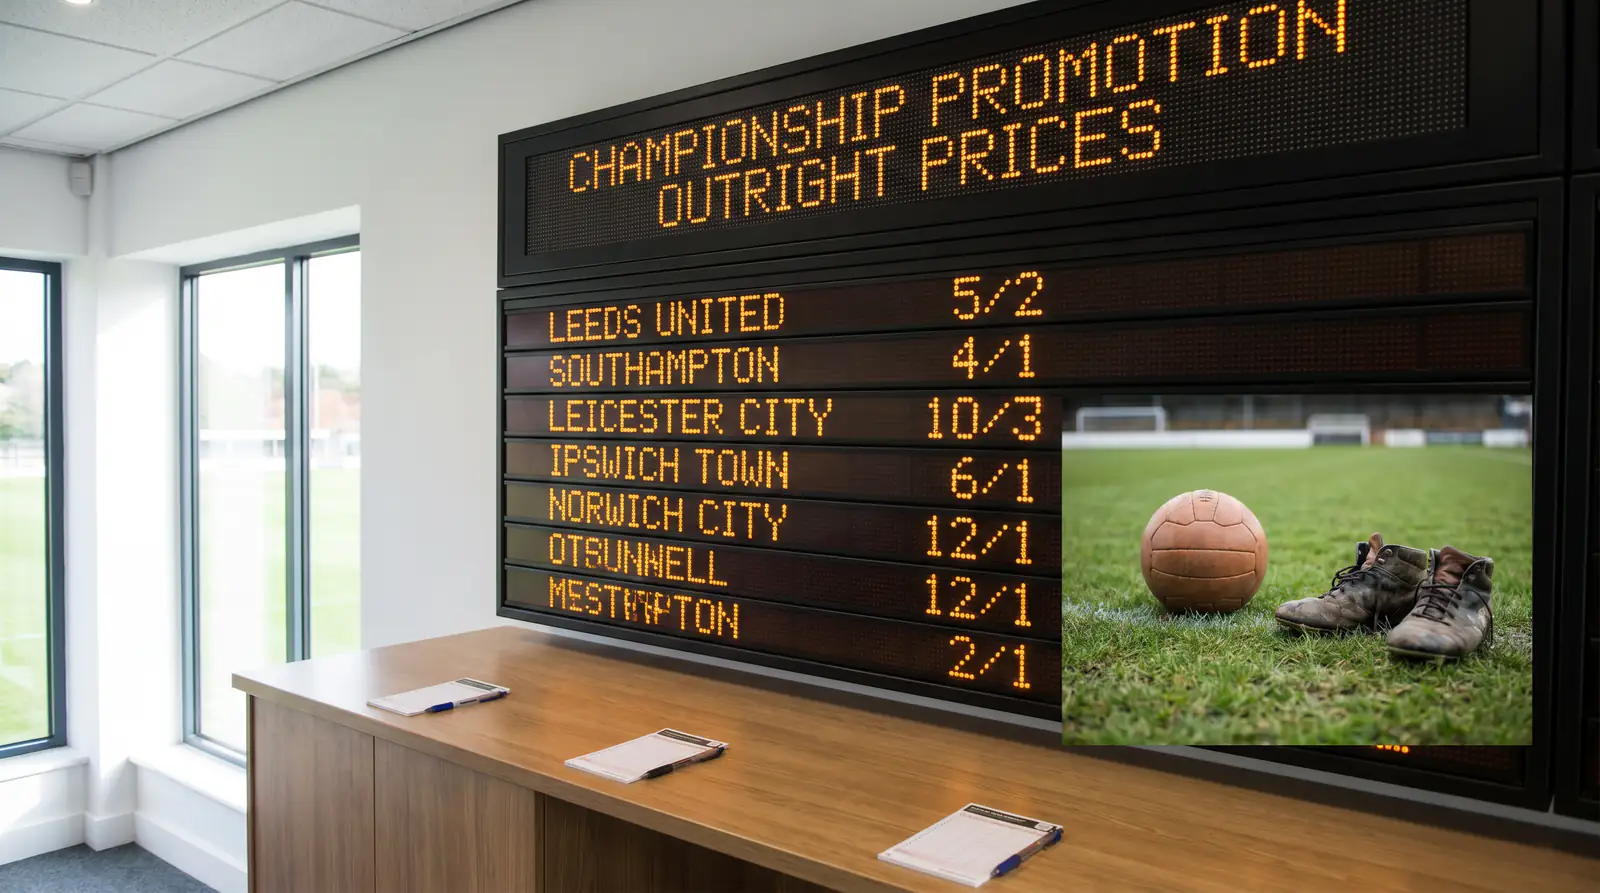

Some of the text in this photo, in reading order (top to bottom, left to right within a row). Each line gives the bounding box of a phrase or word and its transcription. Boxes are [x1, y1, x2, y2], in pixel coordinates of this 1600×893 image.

[570, 0, 1346, 192] CHAMPIONSHIP PROMOTION
[659, 98, 1161, 228] OUTRIGHT PRICES
[549, 271, 1044, 343] LEEDS UNITED 5/2
[549, 333, 1036, 387] SOUTHAMPTON 4/1
[549, 396, 1042, 440] LEICESTER CITY 10/3
[550, 444, 1034, 503] IPSWICH TOWN 6/1
[549, 487, 1033, 565] NORWICH CITY 12/1
[925, 573, 1032, 627] 12/1
[948, 635, 1031, 689] 2/1
